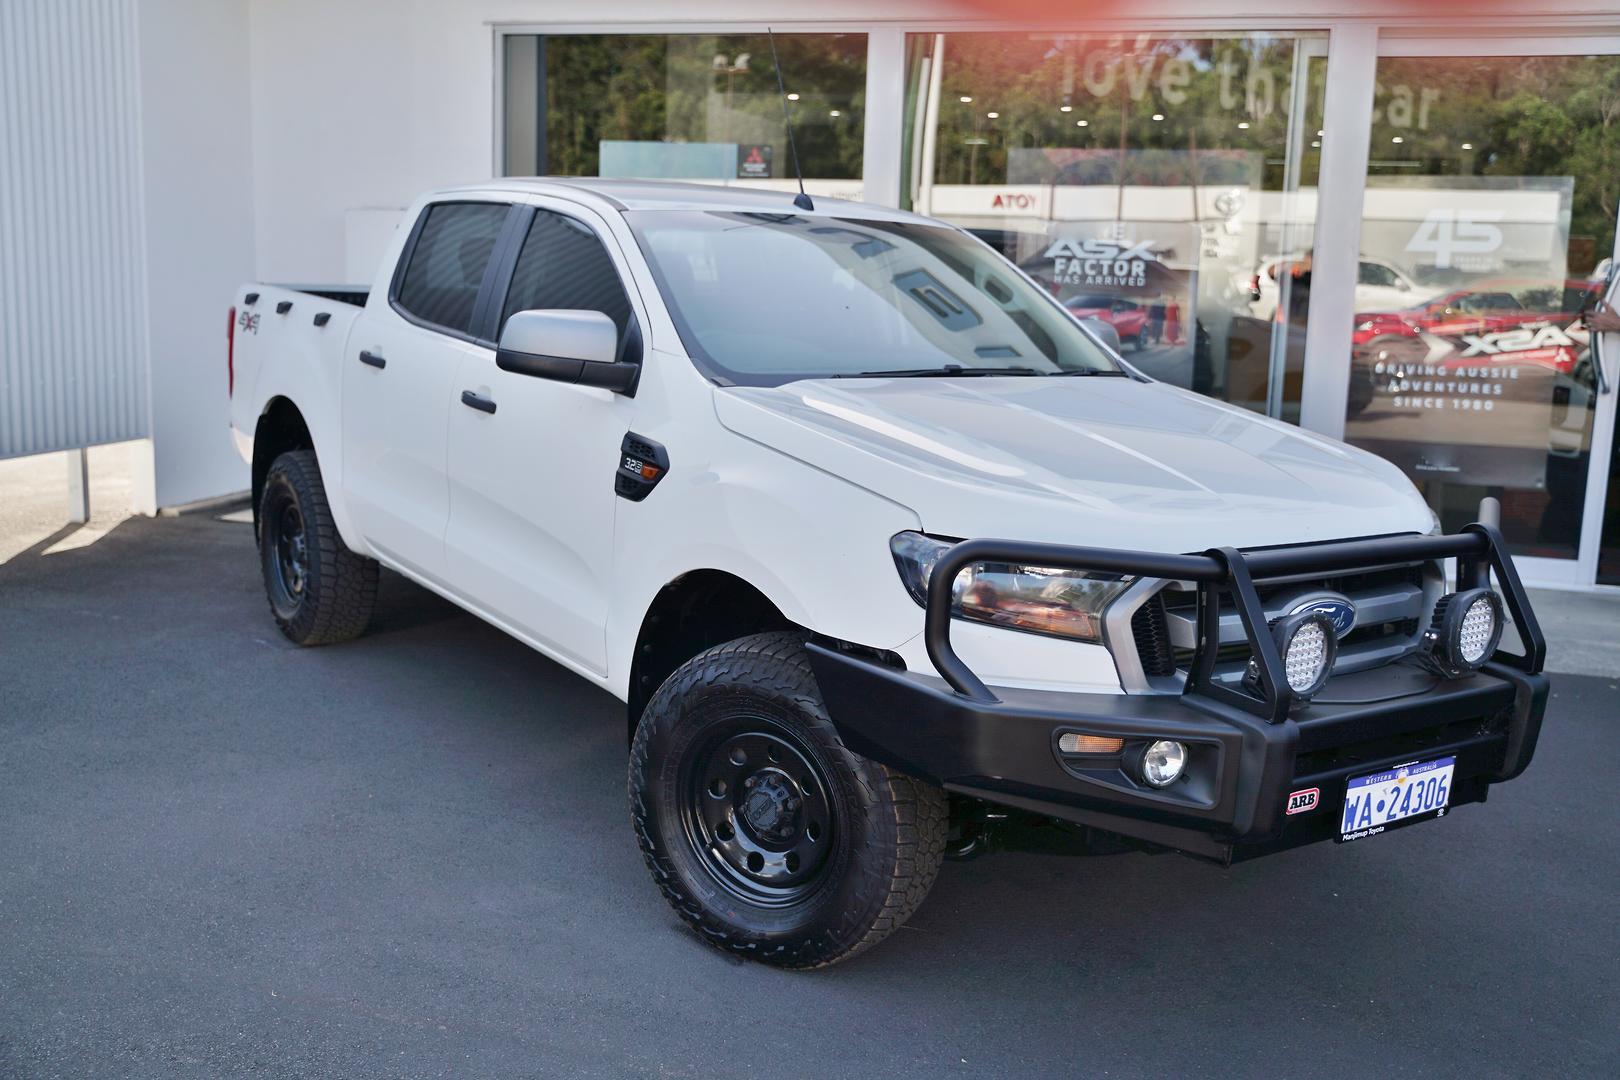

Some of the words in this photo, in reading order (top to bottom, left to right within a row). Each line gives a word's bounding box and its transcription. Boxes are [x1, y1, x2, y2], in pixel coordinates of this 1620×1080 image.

[1405, 209, 1504, 269] 45
[1043, 239, 1158, 261] ASX
[1054, 257, 1146, 277] FACTOR
[1054, 275, 1080, 285] HAS
[1085, 276, 1146, 287] ARRIVED
[1455, 366, 1519, 379] AUSSIE
[1388, 379, 1502, 395] ADVENTURES
[1393, 396, 1444, 409] SINCE
[1453, 399, 1494, 411] 1980
[1365, 774, 1392, 785] WESTERN
[1413, 762, 1437, 775] AUSTRALIA
[1290, 793, 1315, 810] ARB
[1368, 826, 1385, 836] Toyota
